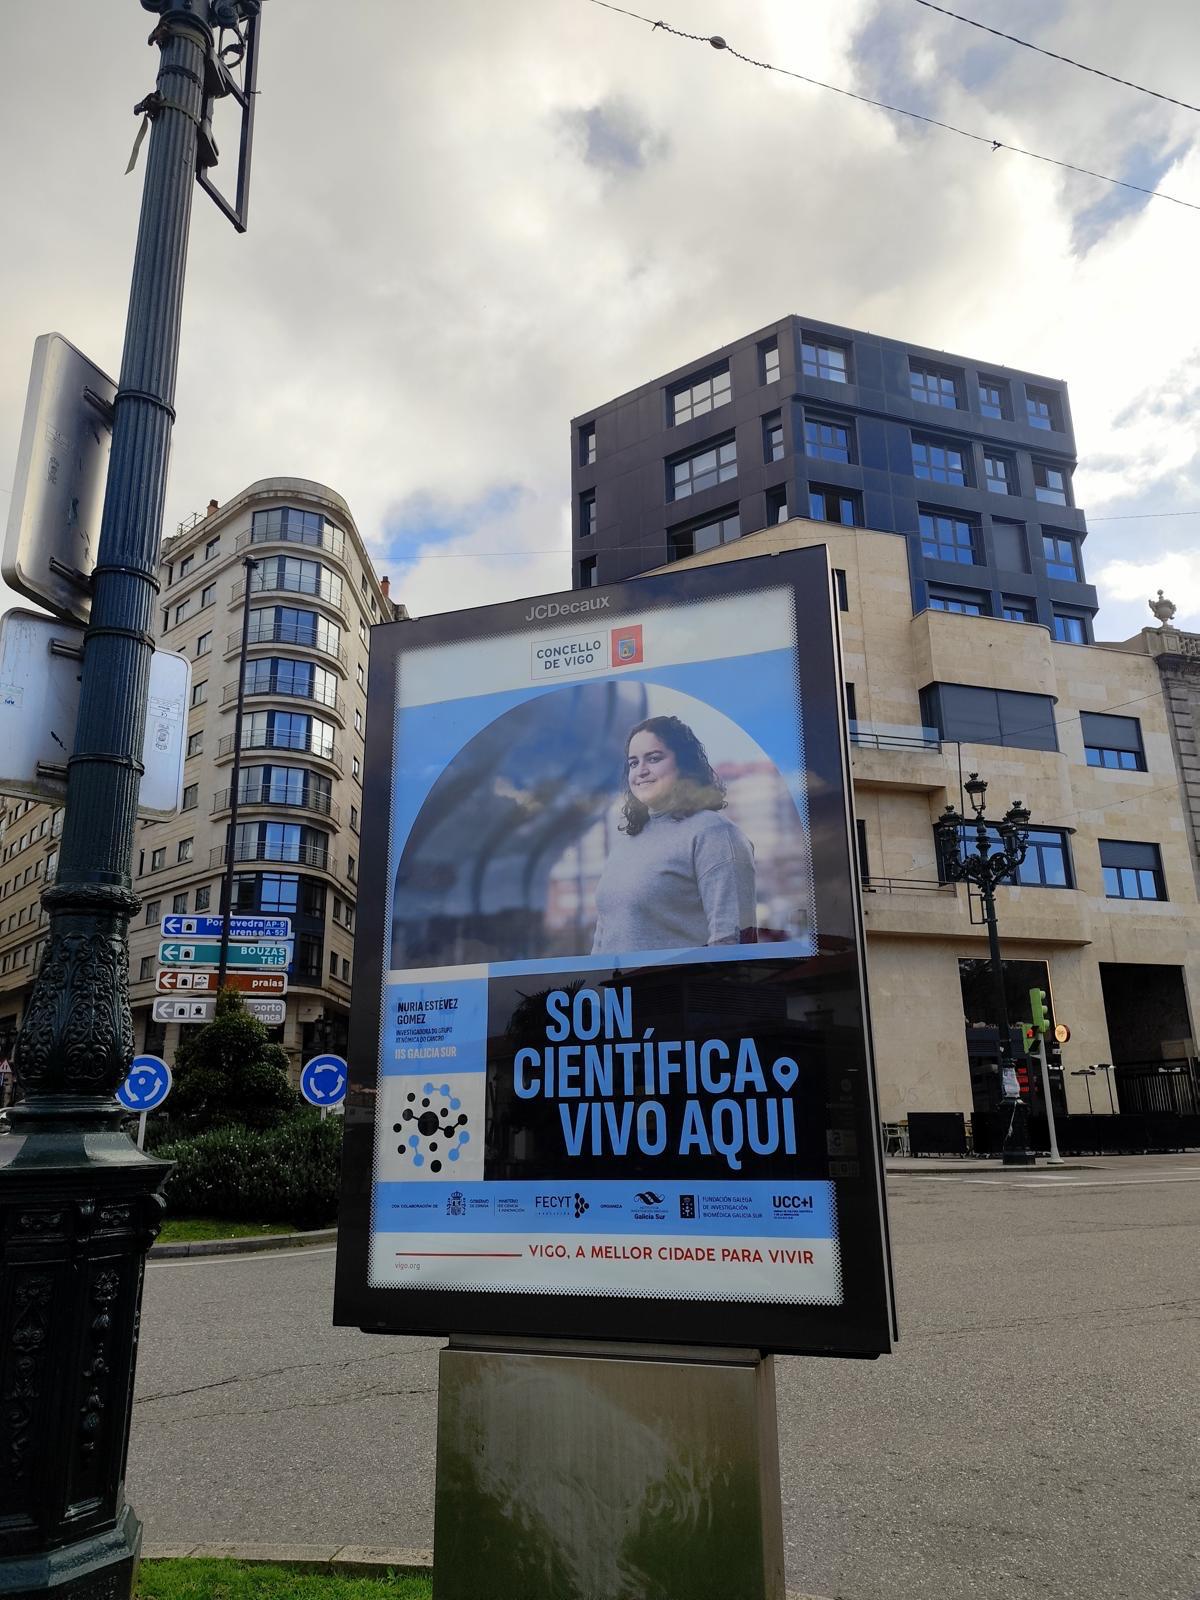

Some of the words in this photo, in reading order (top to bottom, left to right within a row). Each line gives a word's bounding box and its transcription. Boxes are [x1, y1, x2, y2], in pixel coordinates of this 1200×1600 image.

[525, 596, 610, 621] JCDecaux
[537, 640, 601, 659] CONCELLO
[544, 660, 560, 670] DE
[565, 654, 594, 667] VIGO
[206, 918, 263, 928] Ponevedra
[266, 920, 285, 928] AP-9
[221, 929, 264, 937] urense
[266, 929, 285, 937] A-52
[241, 947, 285, 956] BOUZAS
[261, 956, 285, 965] TEIS
[252, 978, 283, 988] praias
[398, 1001, 423, 1013] NURIA
[425, 997, 458, 1011] ESTÉVEZ
[397, 1012, 426, 1025] GÓMEZ
[546, 987, 633, 1042] SON
[407, 1047, 440, 1059] GALICIA
[440, 1046, 456, 1057] SUR
[513, 1027, 768, 1099] CIENTÍFICA
[559, 1101, 667, 1156] VIVO
[678, 1098, 797, 1170] AQUI
[535, 1196, 572, 1208] FECYT
[773, 1195, 813, 1209] UCC+I
[529, 1245, 570, 1259] VIGO,
[575, 1245, 585, 1258] A
[591, 1246, 652, 1260] MELLOR
[658, 1247, 716, 1261] CIDADE
[722, 1249, 763, 1263] PARA
[768, 1250, 814, 1264] VIVIR
[395, 1262, 421, 1270] vigo.org
